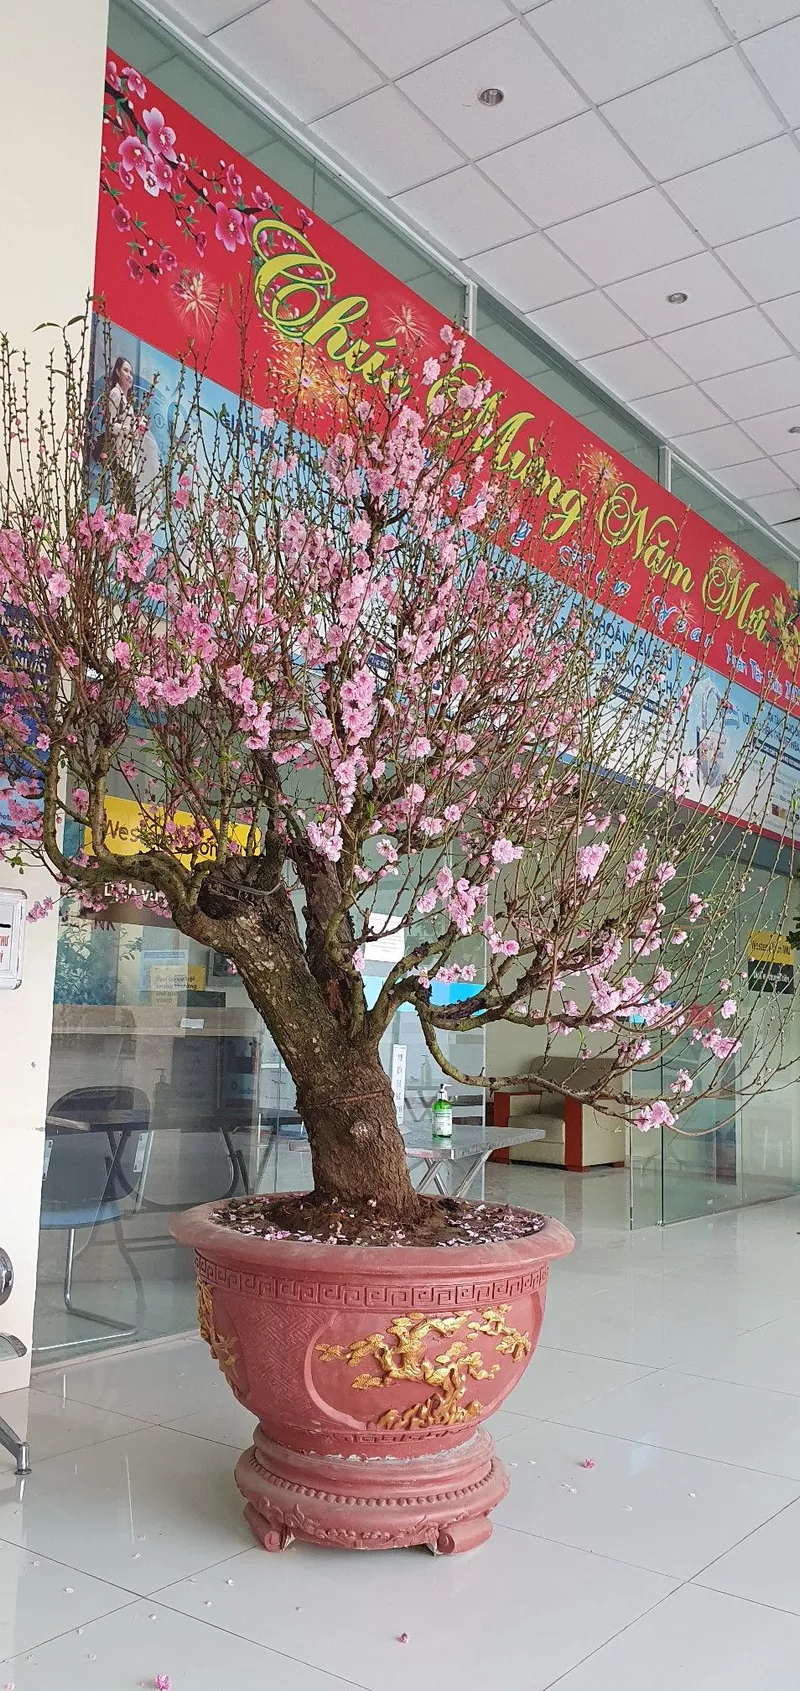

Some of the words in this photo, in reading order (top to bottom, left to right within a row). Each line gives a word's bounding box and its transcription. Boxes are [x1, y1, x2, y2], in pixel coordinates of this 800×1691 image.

[252, 218, 413, 400] Chúc
[599, 483, 694, 593] Năm
[701, 553, 771, 643] Mới
